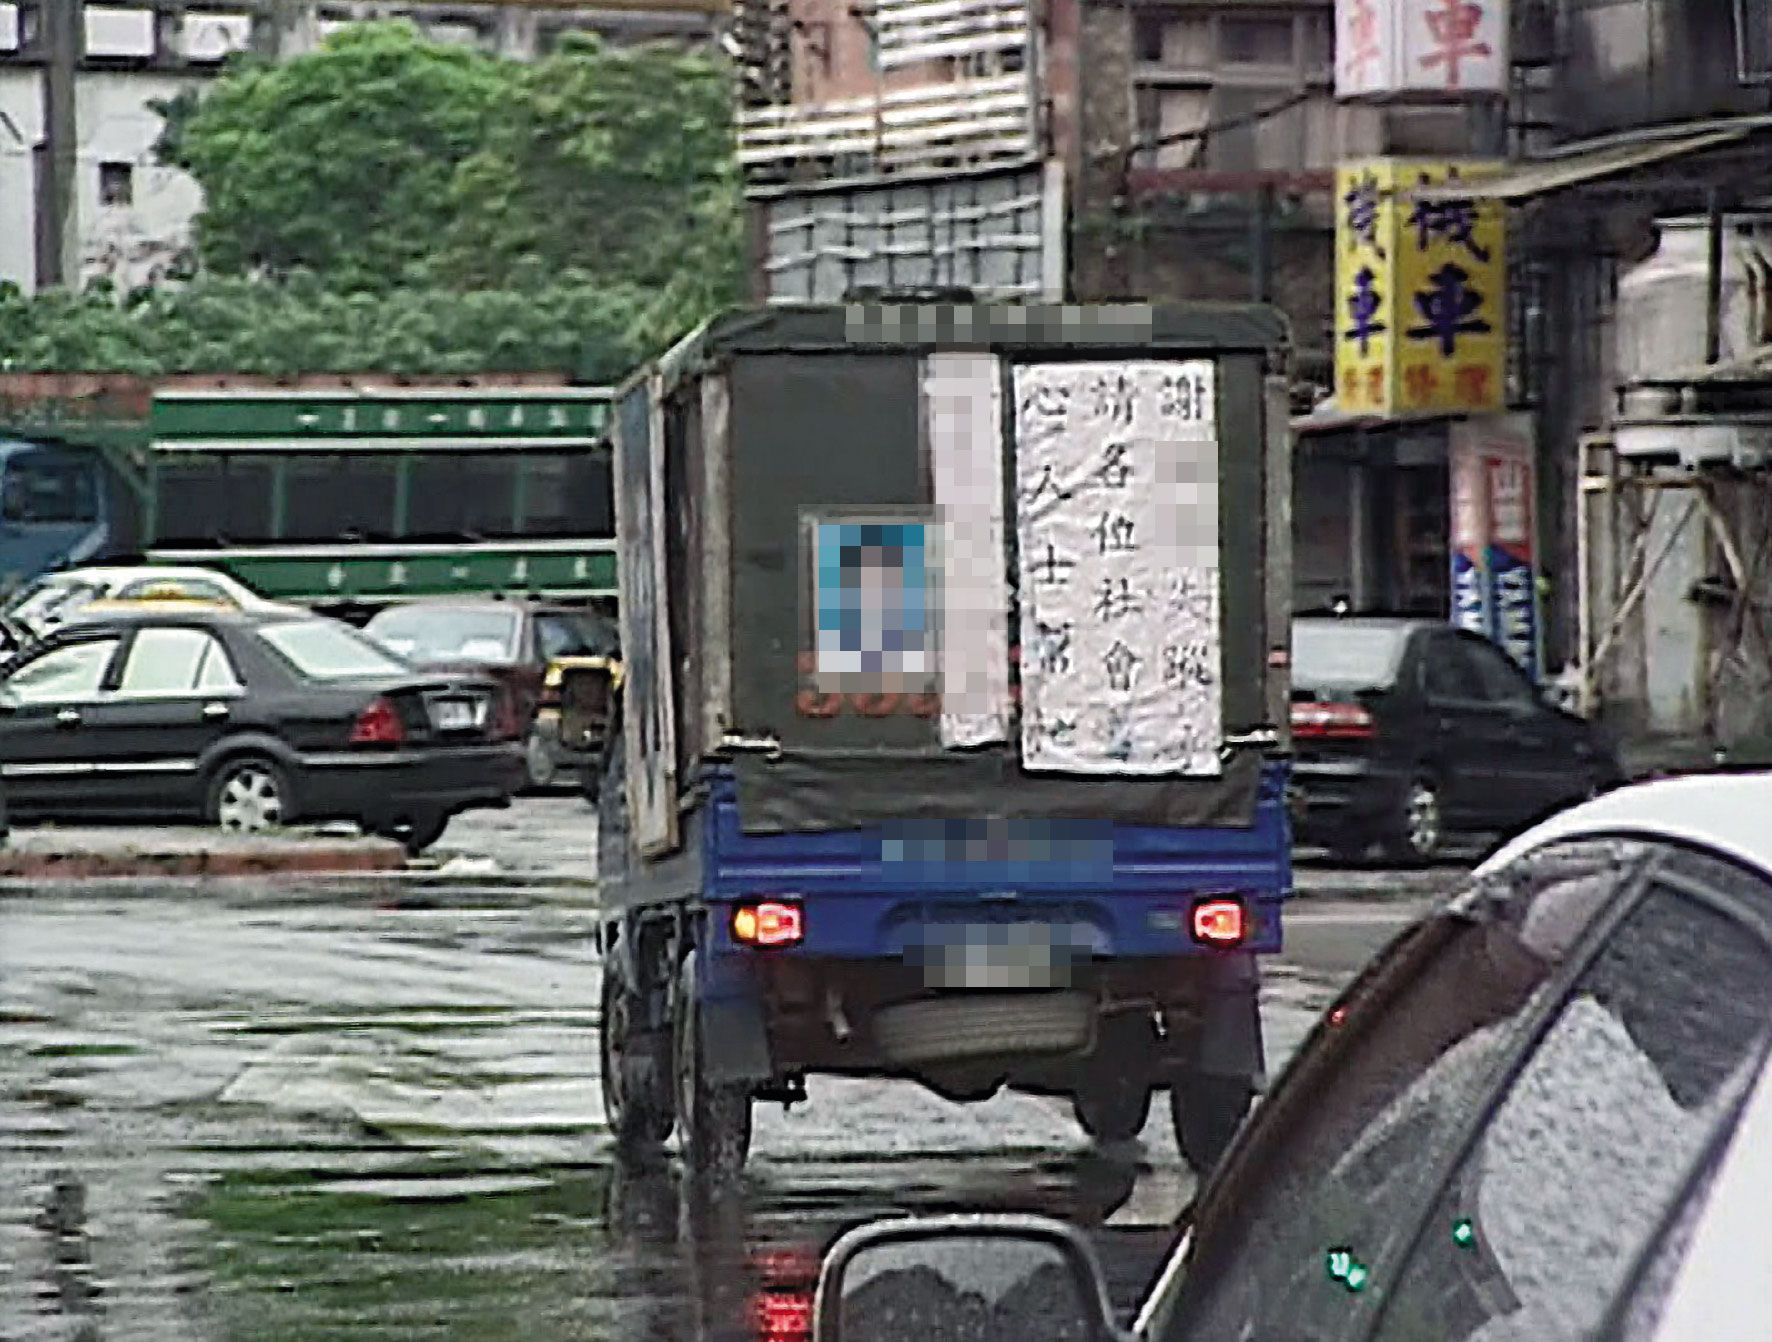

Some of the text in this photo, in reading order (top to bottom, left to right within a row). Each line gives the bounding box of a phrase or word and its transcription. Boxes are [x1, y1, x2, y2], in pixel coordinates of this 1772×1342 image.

[1403, 165, 1492, 359] 機車
[1090, 375, 1142, 762] 請各位社會
